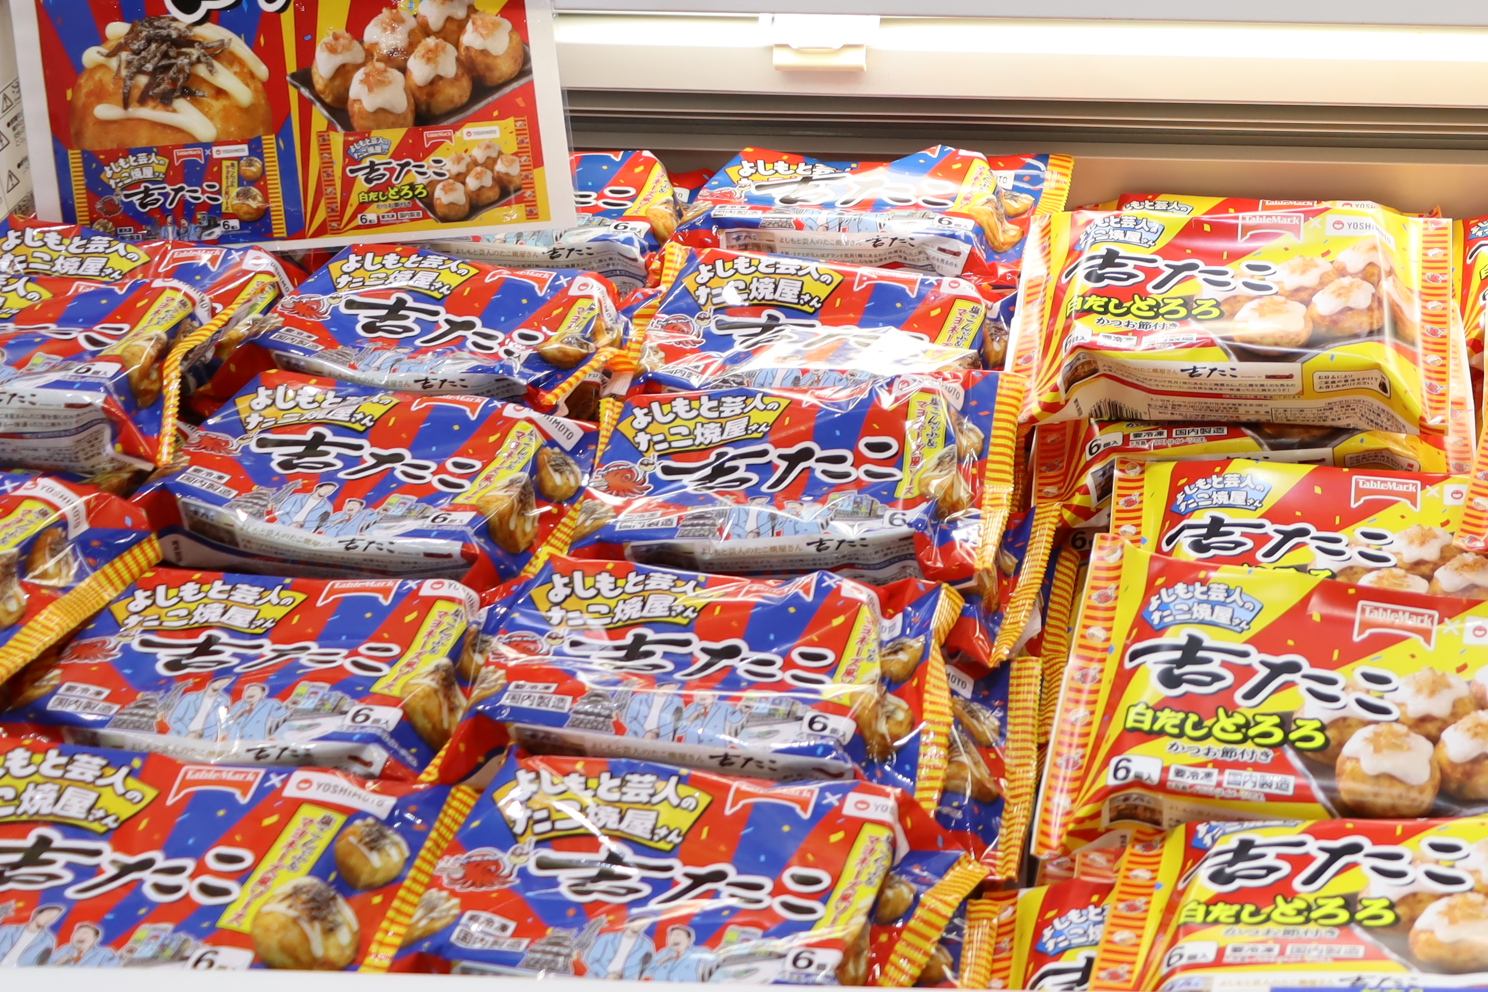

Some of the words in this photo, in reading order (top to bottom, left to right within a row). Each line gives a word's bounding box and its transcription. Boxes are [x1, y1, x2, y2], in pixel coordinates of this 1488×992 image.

[348, 159, 449, 185] 吉たこ
[122, 182, 223, 210] 吉たこ
[359, 185, 428, 203] 白だしとろろ
[2, 229, 140, 263] よしもと芸人の
[546, 245, 594, 260] 吉たこ
[871, 235, 916, 250] 吉たこ
[341, 253, 468, 277] よしもと芸人の
[696, 257, 832, 287] よしもと芸人の
[1062, 247, 1279, 295] 吉たこ
[1066, 295, 1223, 319] 白だしとろろ
[1095, 316, 1179, 331] かつお節付き
[413, 375, 469, 390] 吉たこ
[1179, 365, 1239, 379] 吉たこ
[252, 386, 394, 412] よしもと芸人の
[631, 394, 780, 431] よしもと芸人の
[634, 418, 771, 452] たこ焼屋さん
[1174, 426, 1225, 436] 国内製造
[253, 428, 479, 491] 吉たこ
[658, 437, 901, 491] 吉たこ
[1356, 478, 1420, 494] TableMark
[338, 535, 399, 554] 吉たこ
[806, 536, 870, 554] 吉たこ
[1163, 515, 1398, 567] 吉たこ
[131, 580, 294, 613] よしもと芸人の
[333, 580, 397, 593] TableMark
[1363, 604, 1434, 627] TableMark
[132, 631, 402, 676] 吉たこ
[565, 629, 836, 686] 吉たこ
[1126, 632, 1401, 721] 吉たこ
[504, 691, 572, 711] 国内製造
[349, 706, 394, 727] 6個入
[1123, 704, 1327, 750] 白だしとろろ
[709, 752, 778, 772] 吉たこ
[1167, 740, 1275, 763] かつお節付き
[184, 767, 258, 784] TableMark
[1171, 764, 1218, 785] 要冷凍
[1226, 769, 1294, 793] 国内製造
[512, 769, 698, 812] よしもと芸人の
[1180, 835, 1476, 893] 吉たこ
[532, 845, 828, 918] 吉たこ
[1176, 895, 1397, 927] 白だしとろろ
